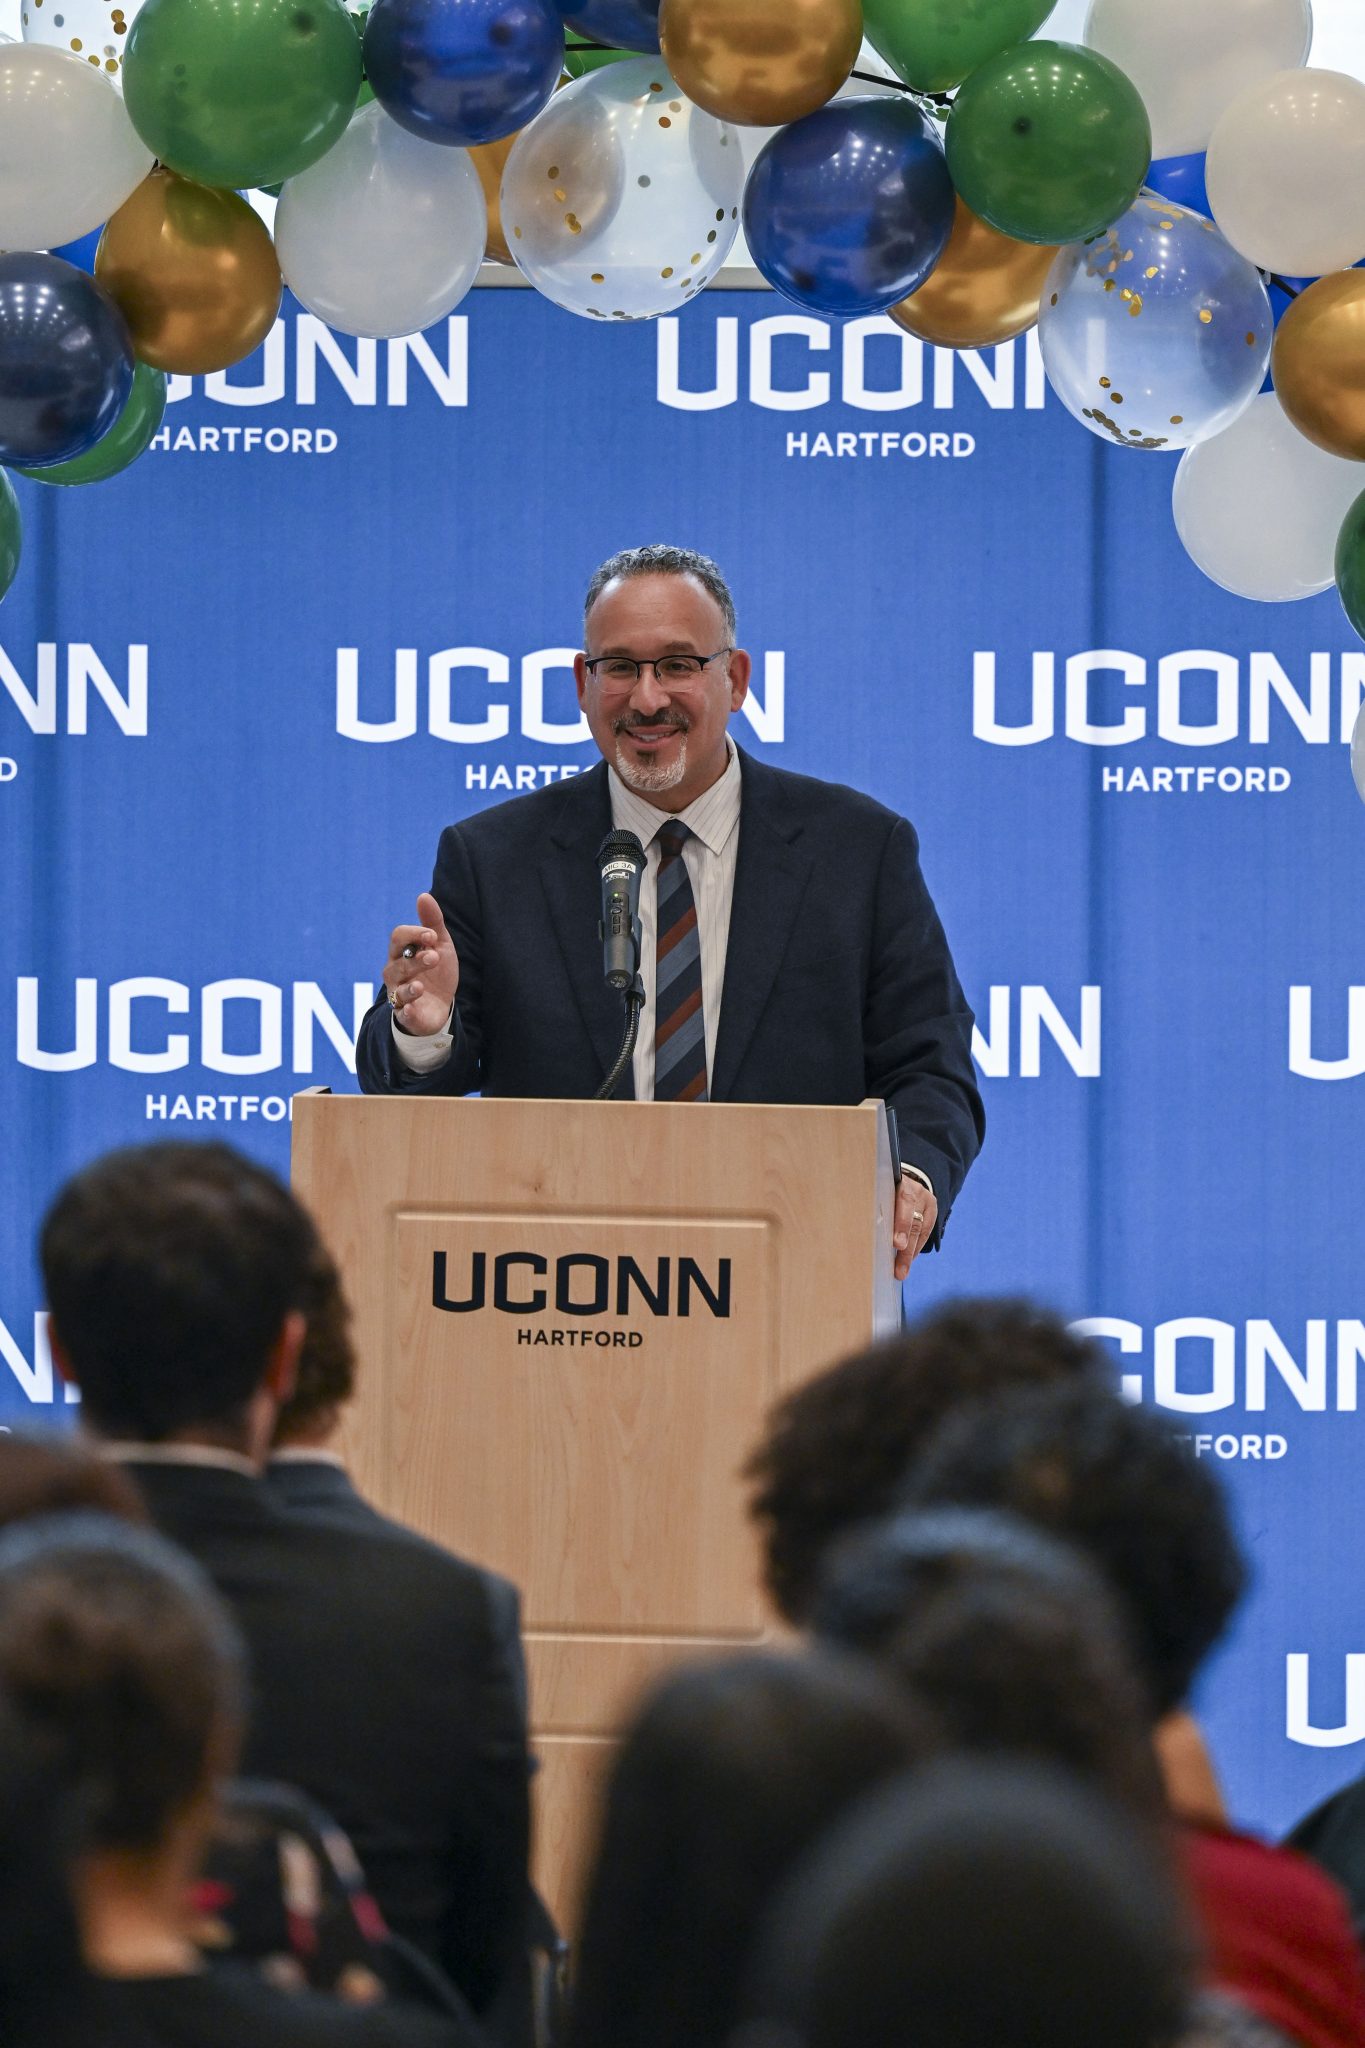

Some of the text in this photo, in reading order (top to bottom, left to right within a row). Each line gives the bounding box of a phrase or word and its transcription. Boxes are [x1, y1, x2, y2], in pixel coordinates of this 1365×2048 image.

[150, 426, 338, 454] HARTFORD
[786, 431, 976, 457] HARTFORD
[1102, 766, 1292, 793] HARTFORD
[604, 862, 633, 874] MIC 3A
[16, 976, 374, 1076] UCON
[145, 1094, 293, 1122] HARTFO
[432, 1251, 731, 1318] UCONN
[517, 1329, 643, 1347] HARTFORD
